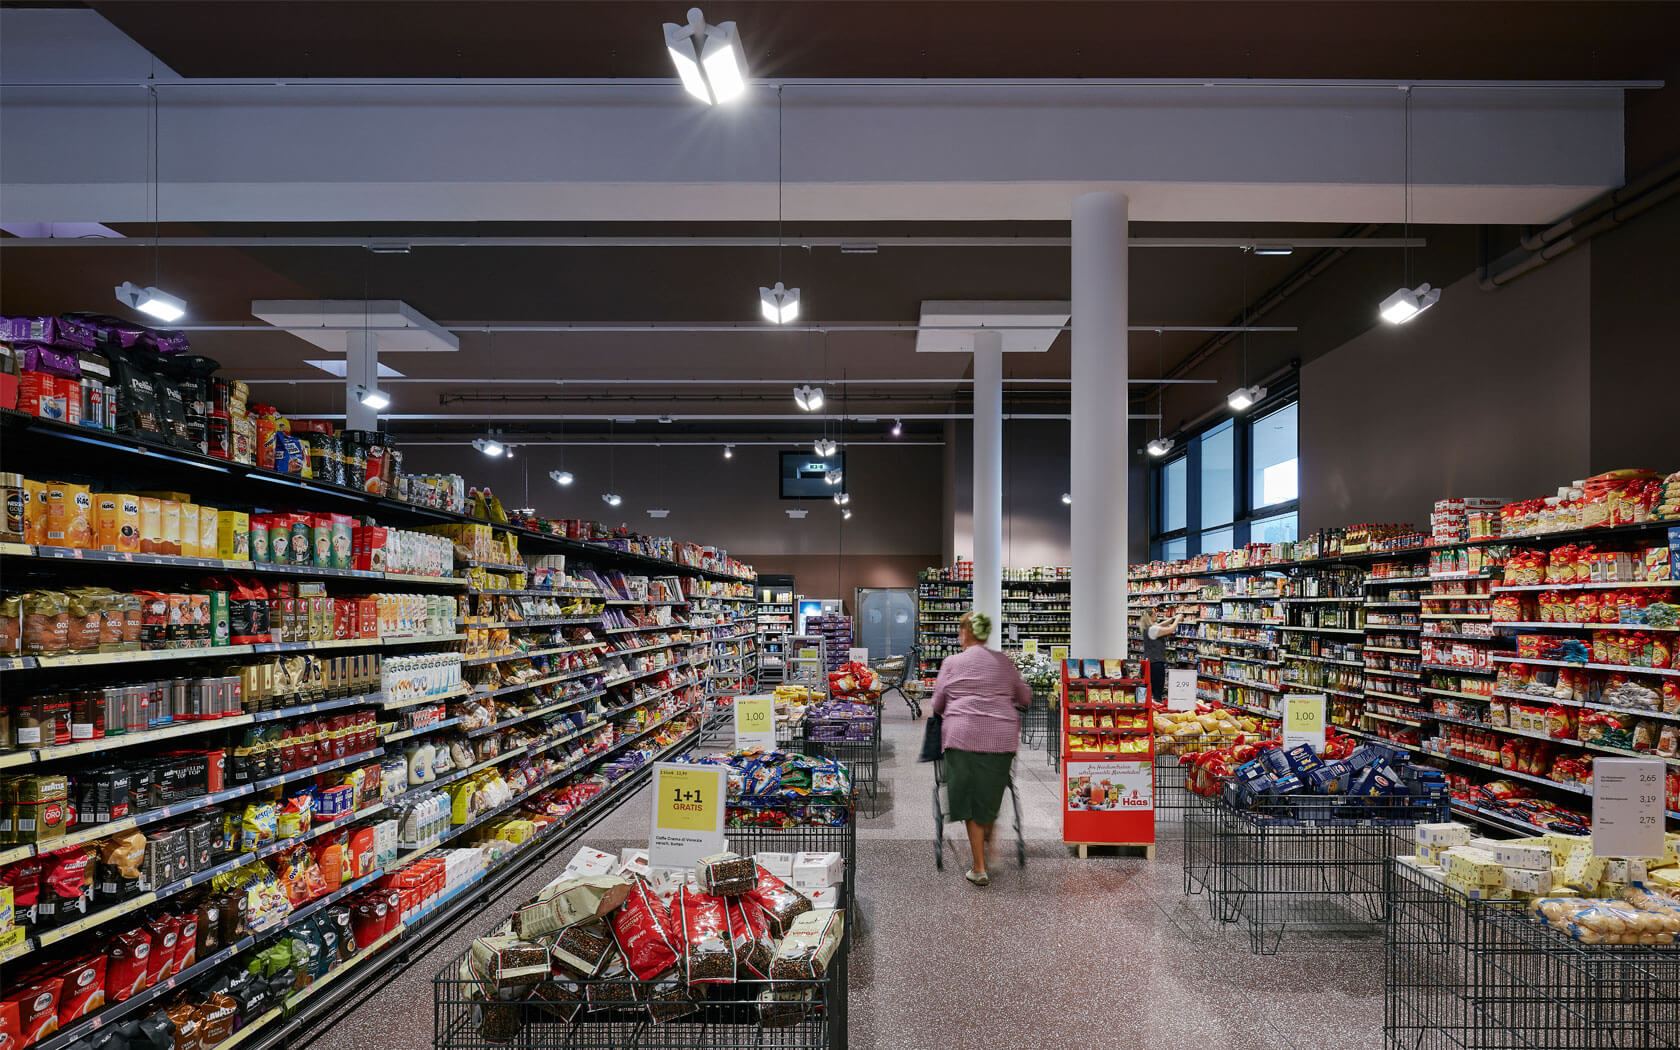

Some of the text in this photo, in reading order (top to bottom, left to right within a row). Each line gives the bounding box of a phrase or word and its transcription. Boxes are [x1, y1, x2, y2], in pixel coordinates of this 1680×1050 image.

[124, 504, 138, 513] HAG
[746, 712, 765, 721] 1,00
[1295, 711, 1315, 721] 1,00
[1639, 774, 1657, 783] 2,65
[673, 788, 703, 804] 1+1
[1639, 795, 1657, 803] 3,19
[1122, 797, 1148, 806] Haas
[672, 803, 703, 812] GRATIS
[45, 811, 61, 820] ORO
[1639, 816, 1656, 825] 2,75
